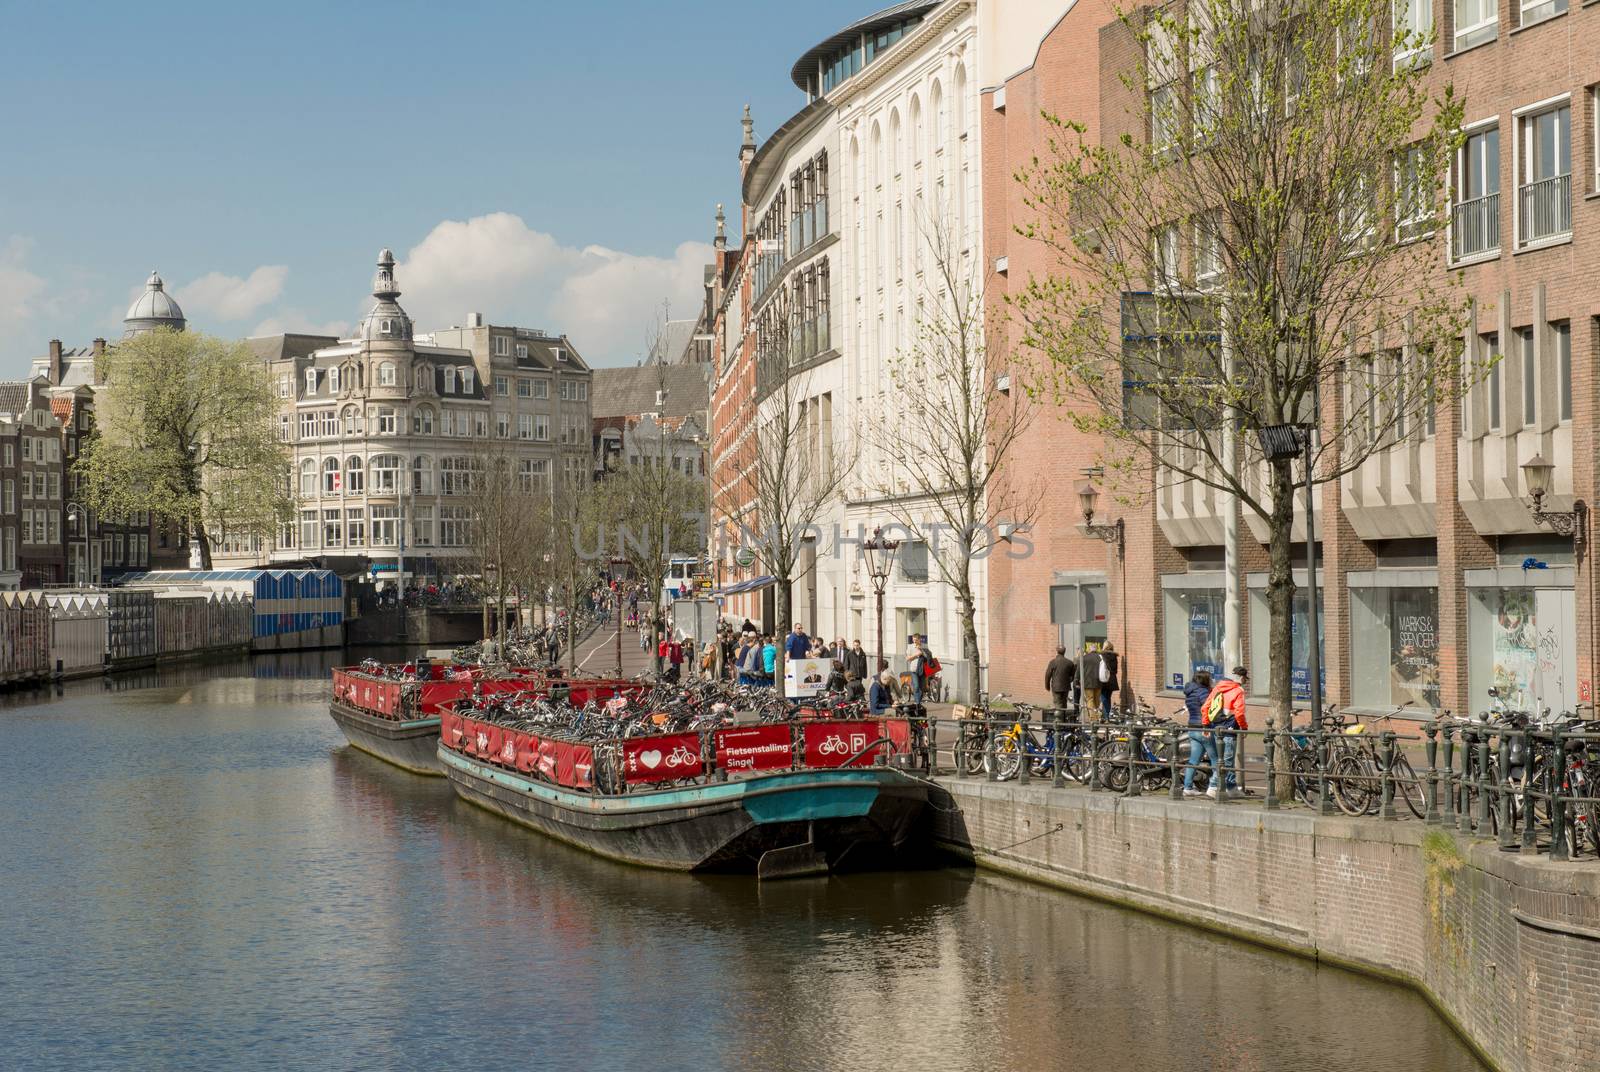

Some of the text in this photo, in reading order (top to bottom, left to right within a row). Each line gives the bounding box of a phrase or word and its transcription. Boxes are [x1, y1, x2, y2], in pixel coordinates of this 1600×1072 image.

[1400, 632, 1435, 648] SPENCER
[726, 743, 789, 757] Fietsenstalling
[853, 737, 864, 751] P
[727, 756, 754, 768] Singel
